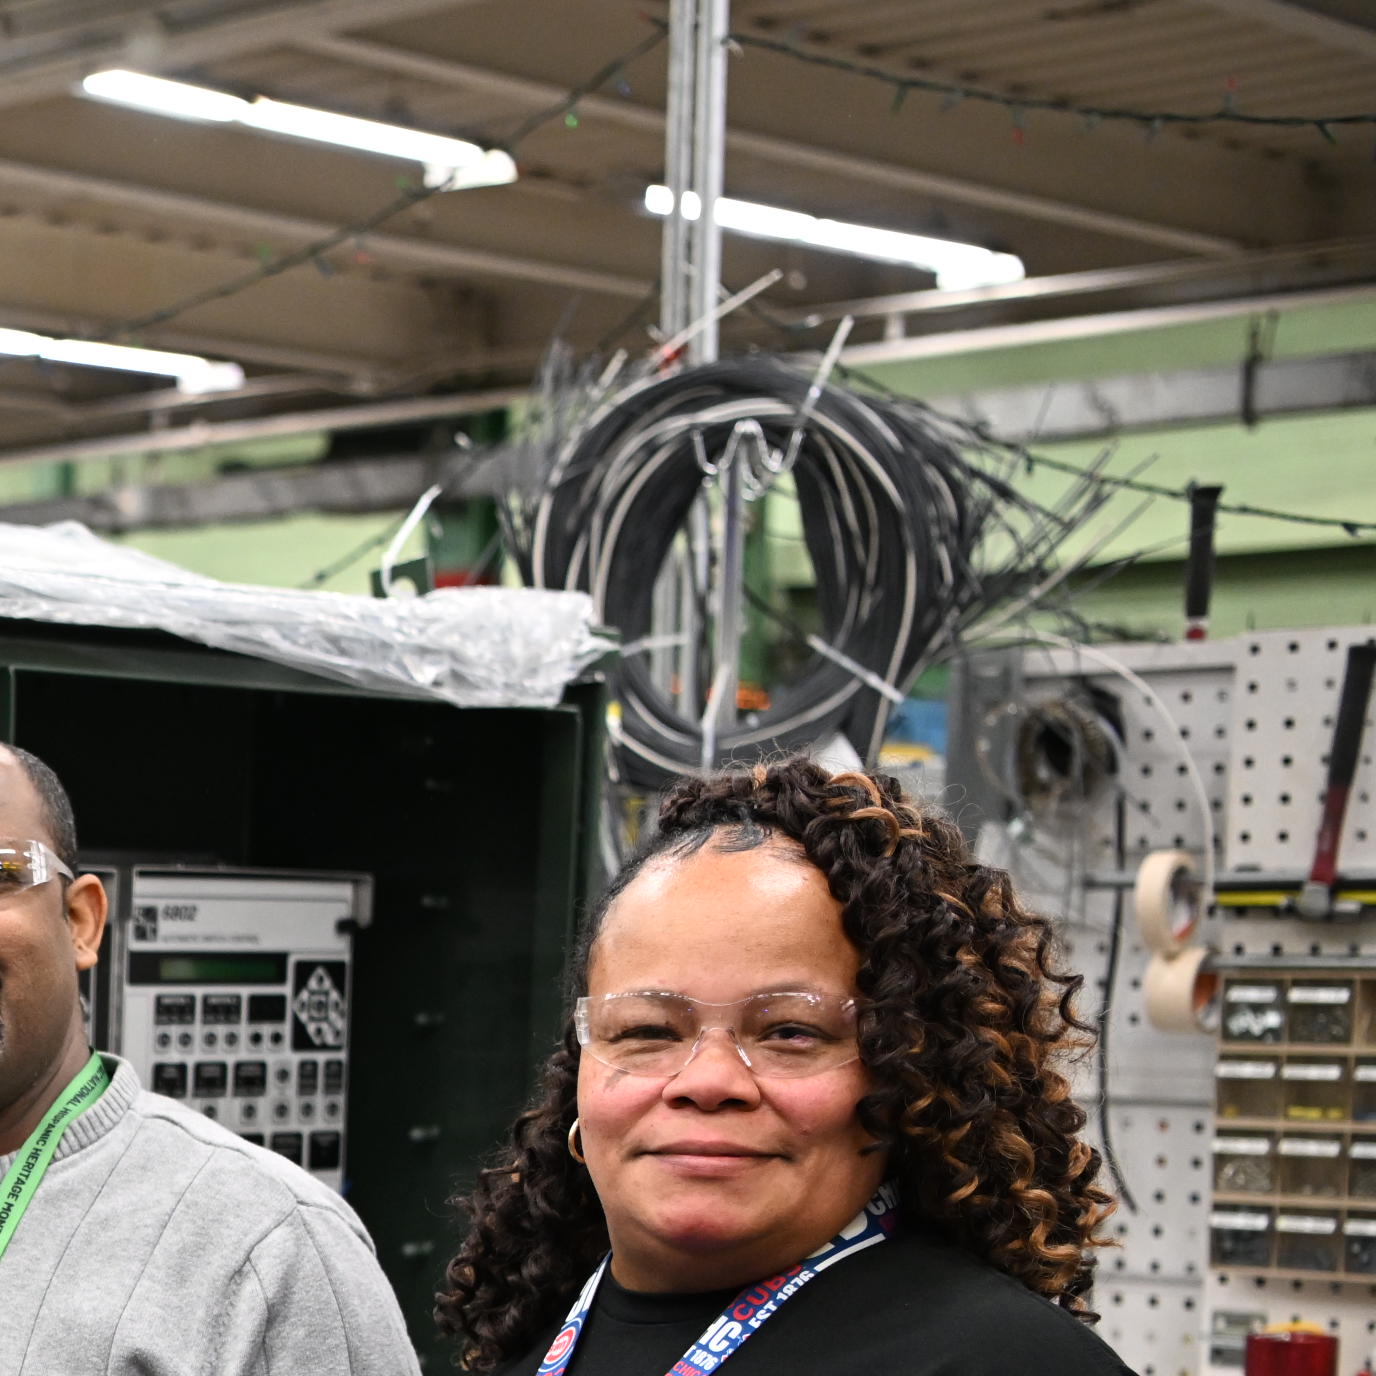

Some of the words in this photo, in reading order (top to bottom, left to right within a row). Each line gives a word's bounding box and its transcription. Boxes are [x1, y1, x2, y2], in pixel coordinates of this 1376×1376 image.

[36, 1106, 72, 1147] HISPANIC
[8, 1147, 43, 1200] HERITAGE
[691, 1348, 720, 1371] 1876
